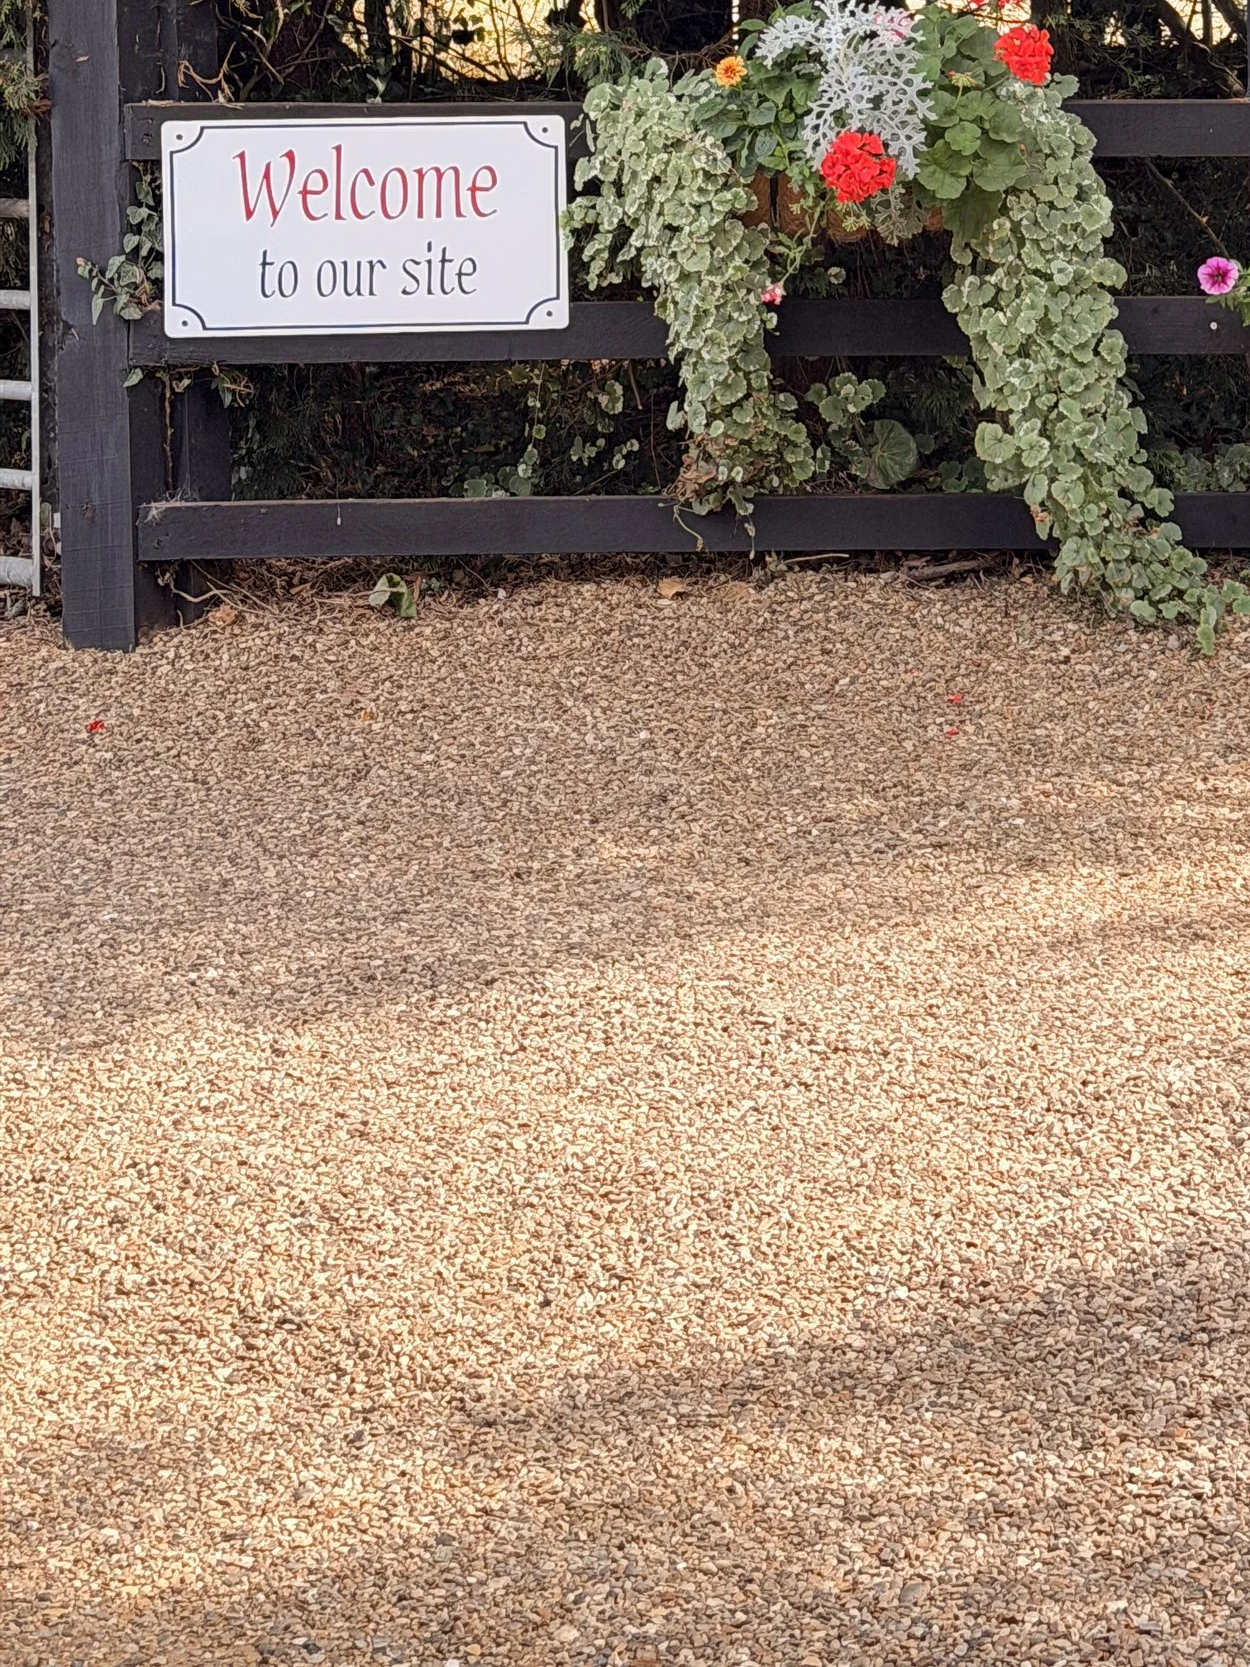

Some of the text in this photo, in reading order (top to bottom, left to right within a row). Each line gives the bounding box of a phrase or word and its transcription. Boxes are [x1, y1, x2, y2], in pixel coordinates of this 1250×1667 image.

[232, 144, 498, 227] Welcome
[259, 240, 477, 298] to our site
